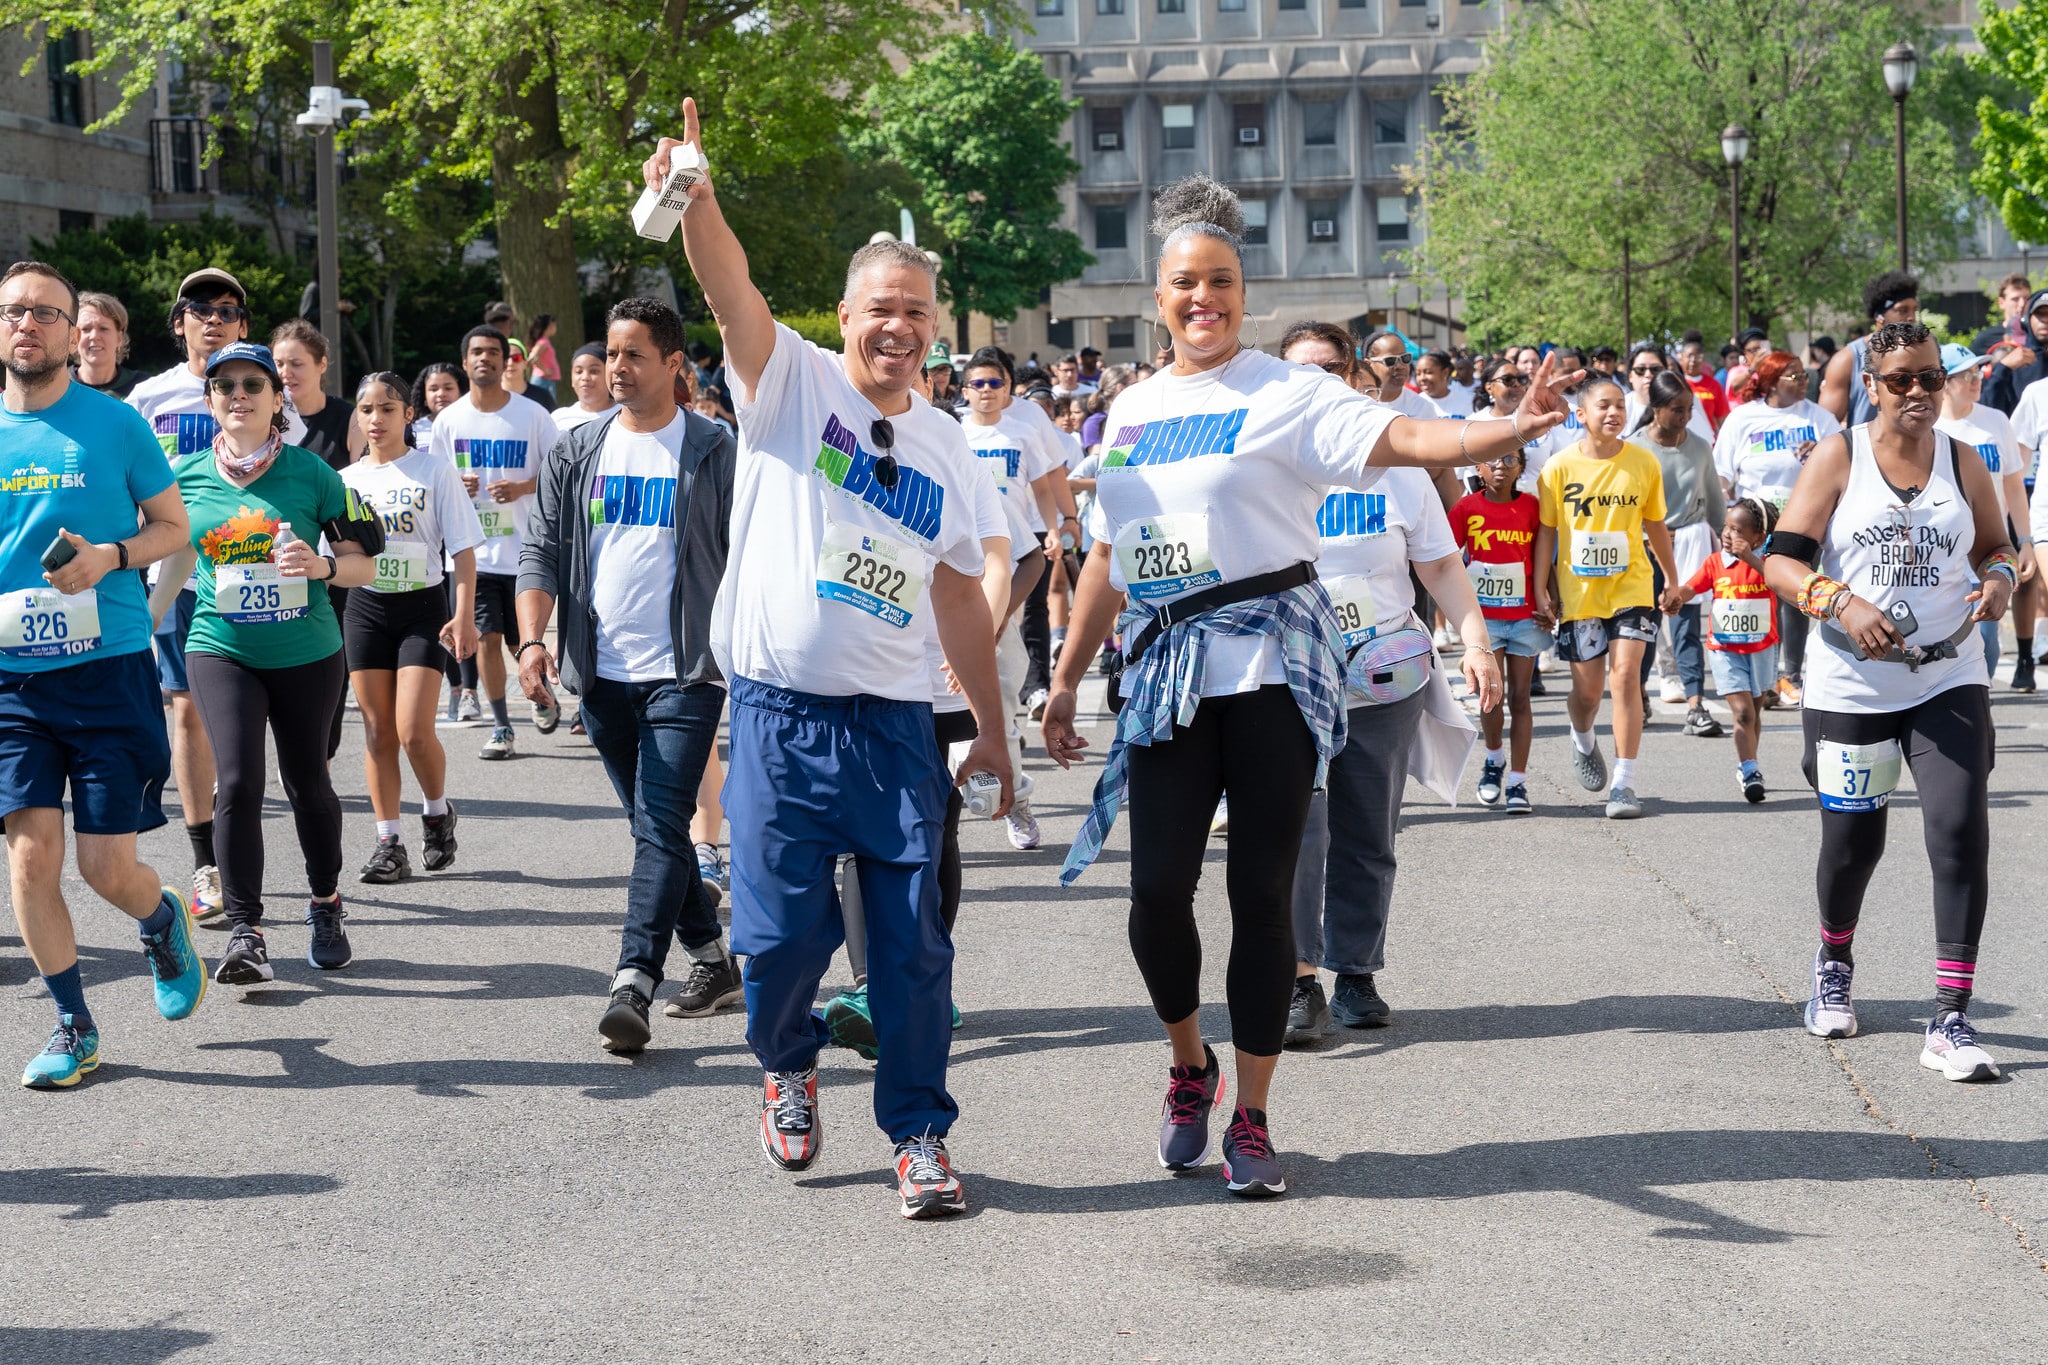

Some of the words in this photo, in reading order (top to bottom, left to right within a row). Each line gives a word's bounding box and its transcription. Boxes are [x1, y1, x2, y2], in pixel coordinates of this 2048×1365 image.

[674, 173, 696, 185] BOXED
[664, 189, 674, 198] IS
[931, 345, 946, 357] LA
[1124, 408, 1249, 467] BRONX
[470, 439, 528, 468] BRONX
[61, 473, 86, 488] 5K
[387, 487, 426, 512] 363
[1597, 495, 1639, 507] WALK
[218, 539, 273, 564] Falling
[1134, 542, 1192, 579] 2323
[1581, 547, 1618, 566] 2109
[843, 552, 906, 604] 2322
[1180, 578, 1194, 590] 2
[1871, 564, 1940, 587] RUNNERS
[397, 582, 414, 592] 5K
[1477, 577, 1513, 597] 2079
[1738, 583, 1769, 594] WALK
[239, 584, 280, 610] 235
[274, 607, 301, 622] 10K
[878, 602, 890, 620] 2
[888, 613, 905, 627] WALK
[21, 611, 68, 642] 326
[1722, 614, 1759, 632] 2080
[62, 638, 95, 656] 10K
[1843, 768, 1871, 795] 37
